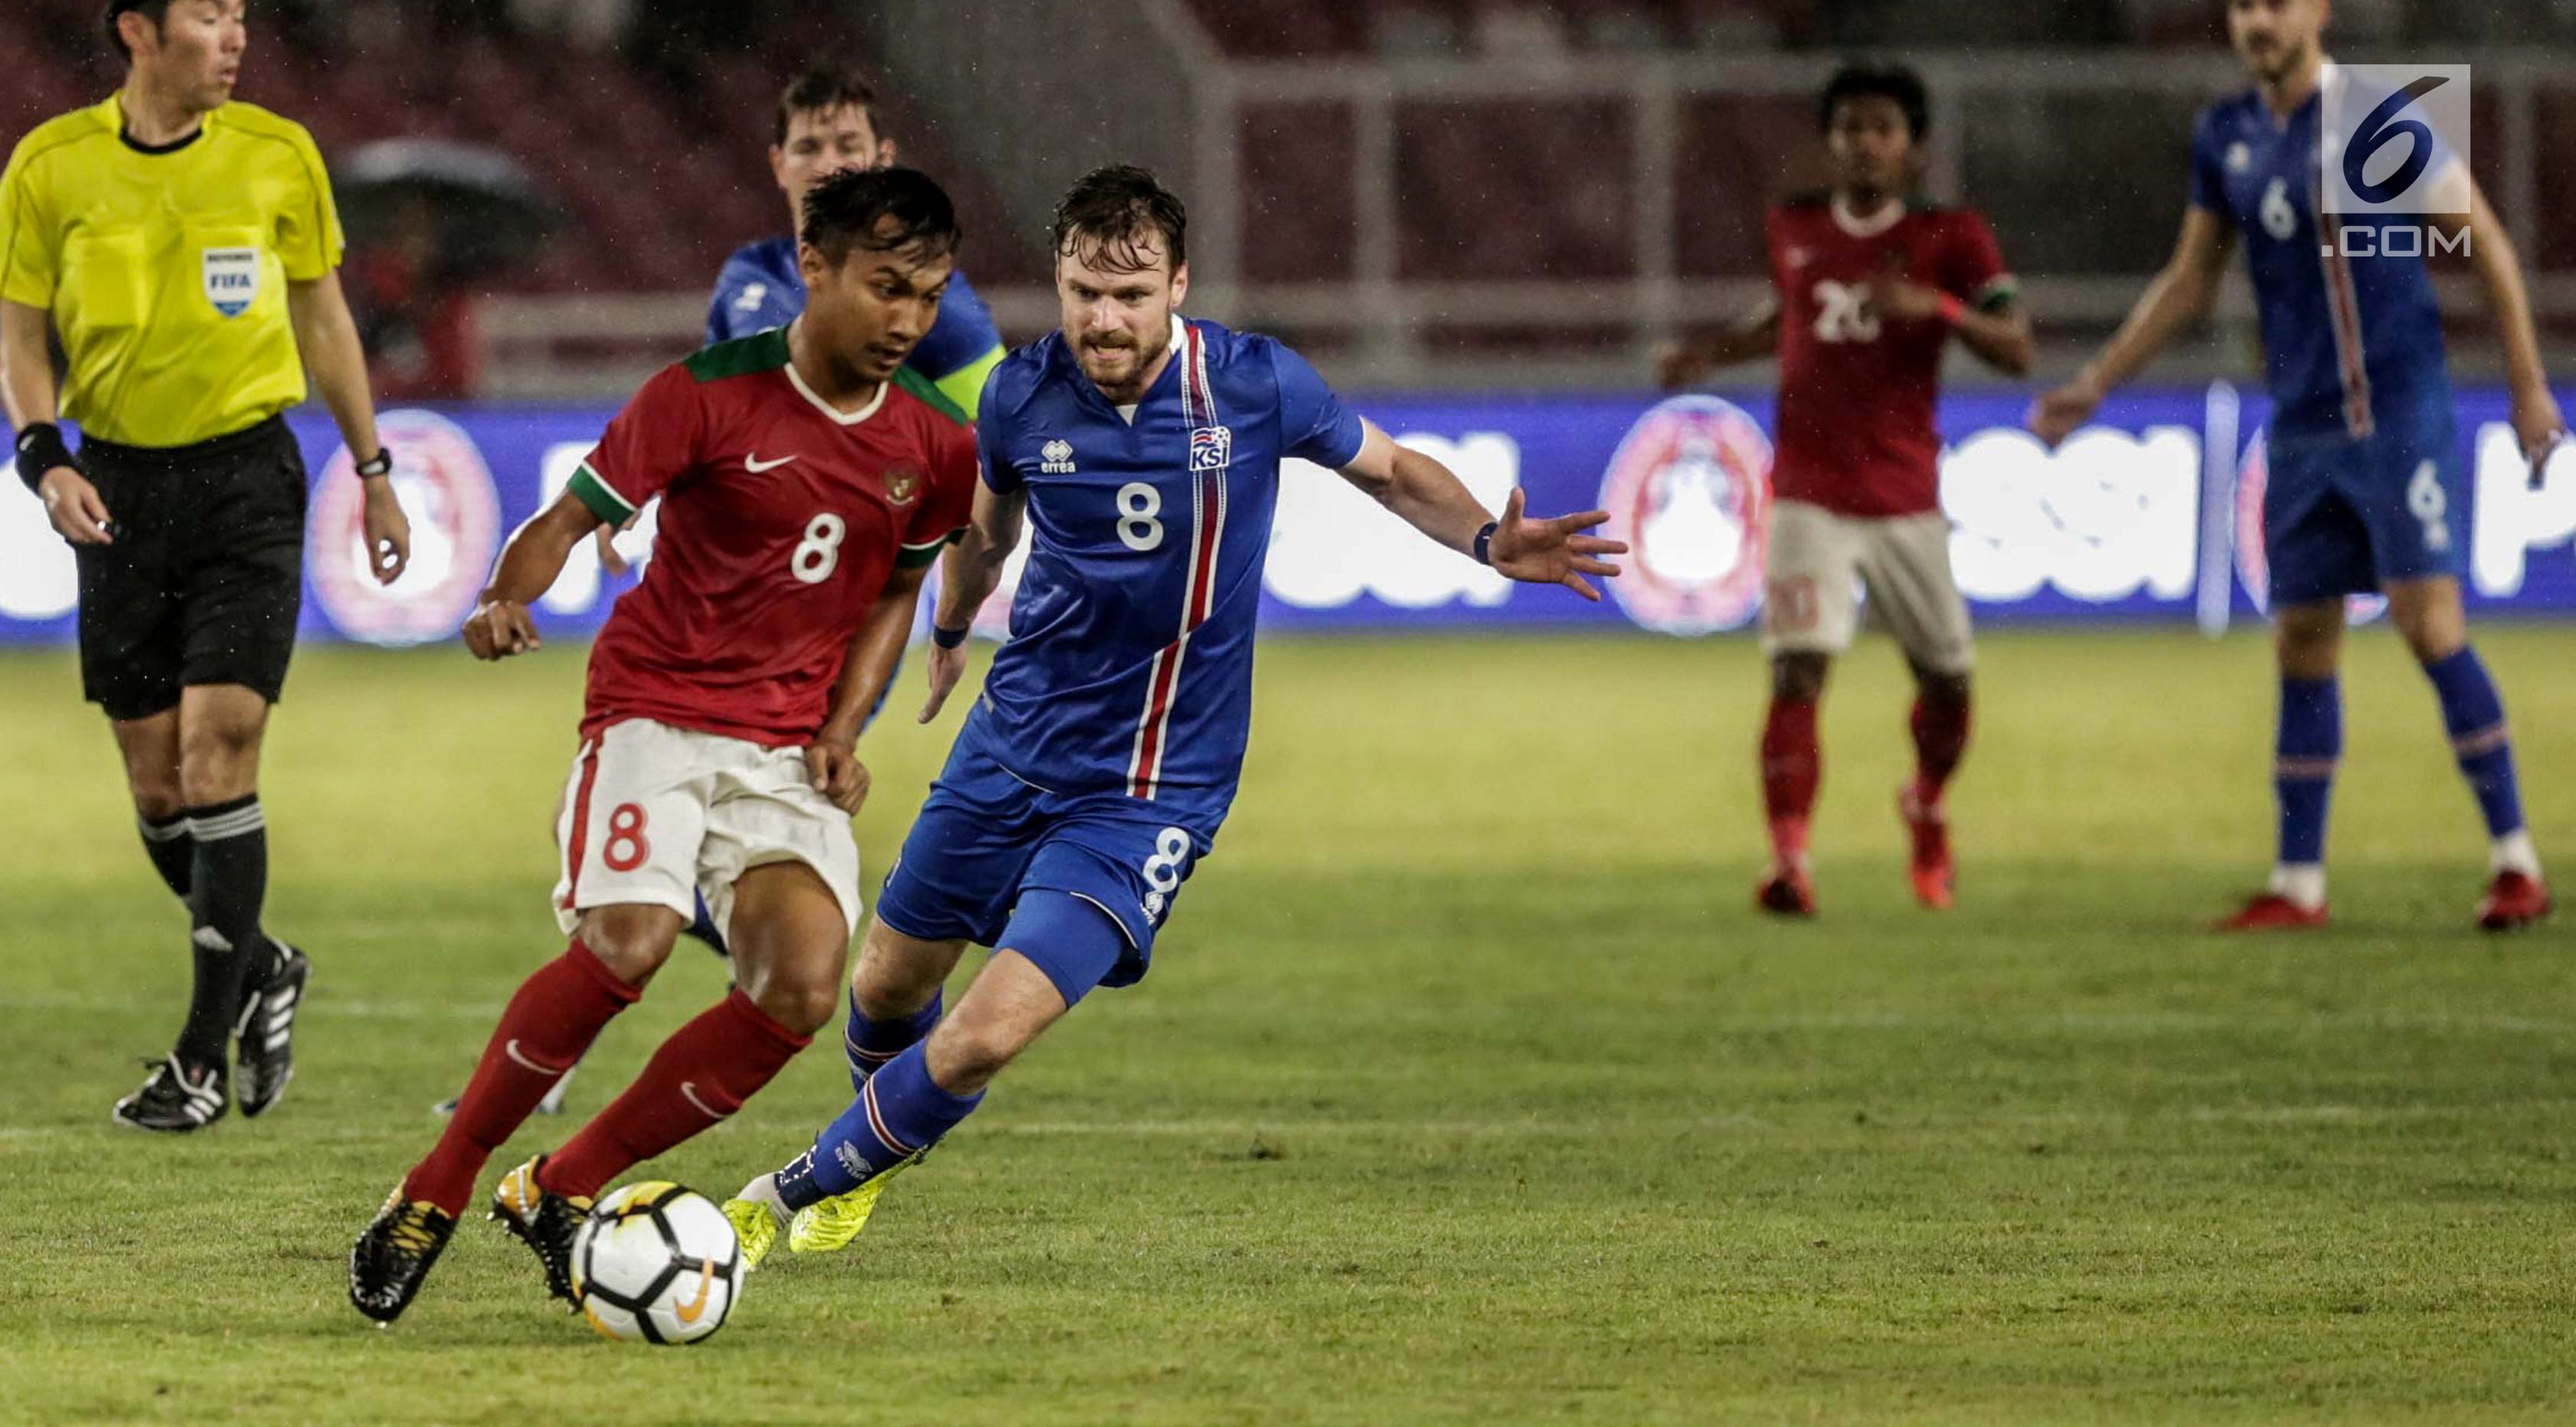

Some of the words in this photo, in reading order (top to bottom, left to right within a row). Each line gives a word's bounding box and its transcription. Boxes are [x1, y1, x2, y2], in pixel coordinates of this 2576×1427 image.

[2258, 176, 2296, 240] 6
[211, 273, 251, 289] FIFA
[1041, 461, 1076, 473] errea
[2407, 458, 2447, 521] 6
[791, 512, 846, 583] 8
[1116, 482, 1165, 551] 8
[603, 803, 650, 872] 8
[1143, 827, 1190, 894] 8
